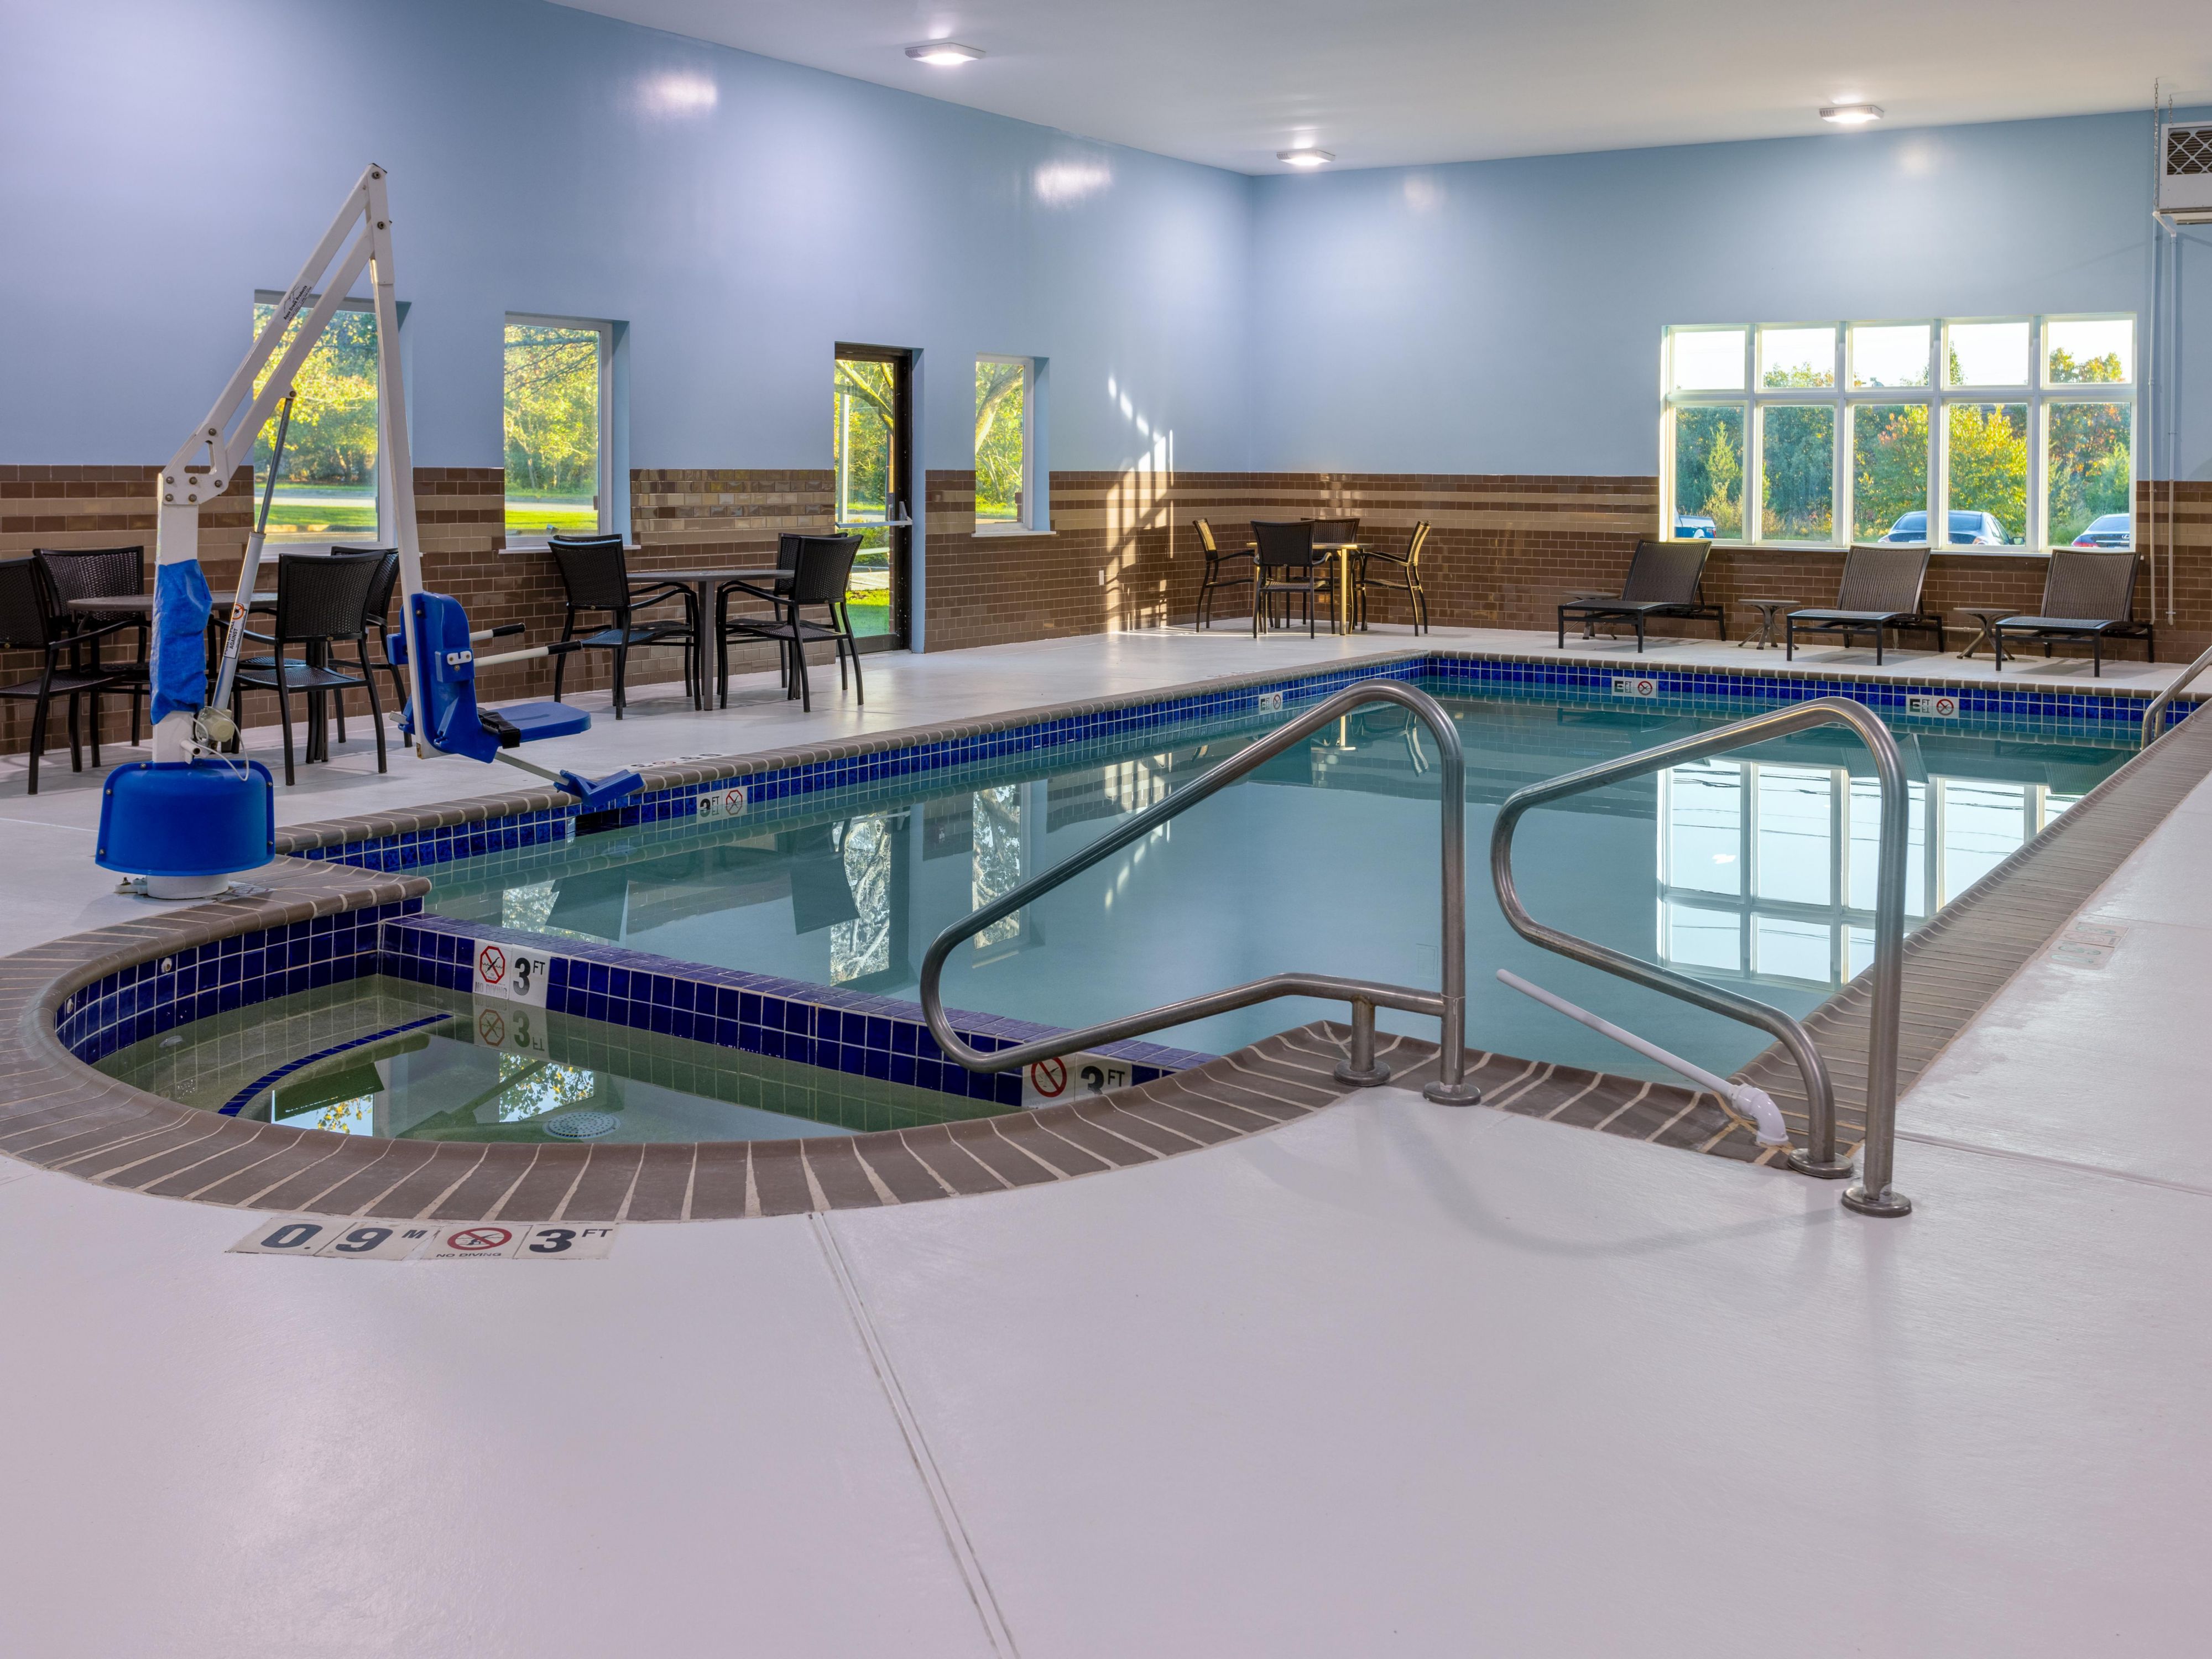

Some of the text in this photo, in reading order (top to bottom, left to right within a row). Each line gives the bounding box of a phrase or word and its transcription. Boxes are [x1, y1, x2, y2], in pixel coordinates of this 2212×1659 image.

[289, 300, 298, 311] Creek
[295, 285, 307, 301] Products
[229, 628, 238, 649] AGAINST
[712, 796, 720, 806] FT
[475, 982, 483, 992] NO
[513, 957, 545, 996] 3 FT
[1108, 1068, 1125, 1087] FT
[401, 1229, 428, 1239] M
[529, 1229, 577, 1253] 3
[582, 1229, 613, 1238] FT
